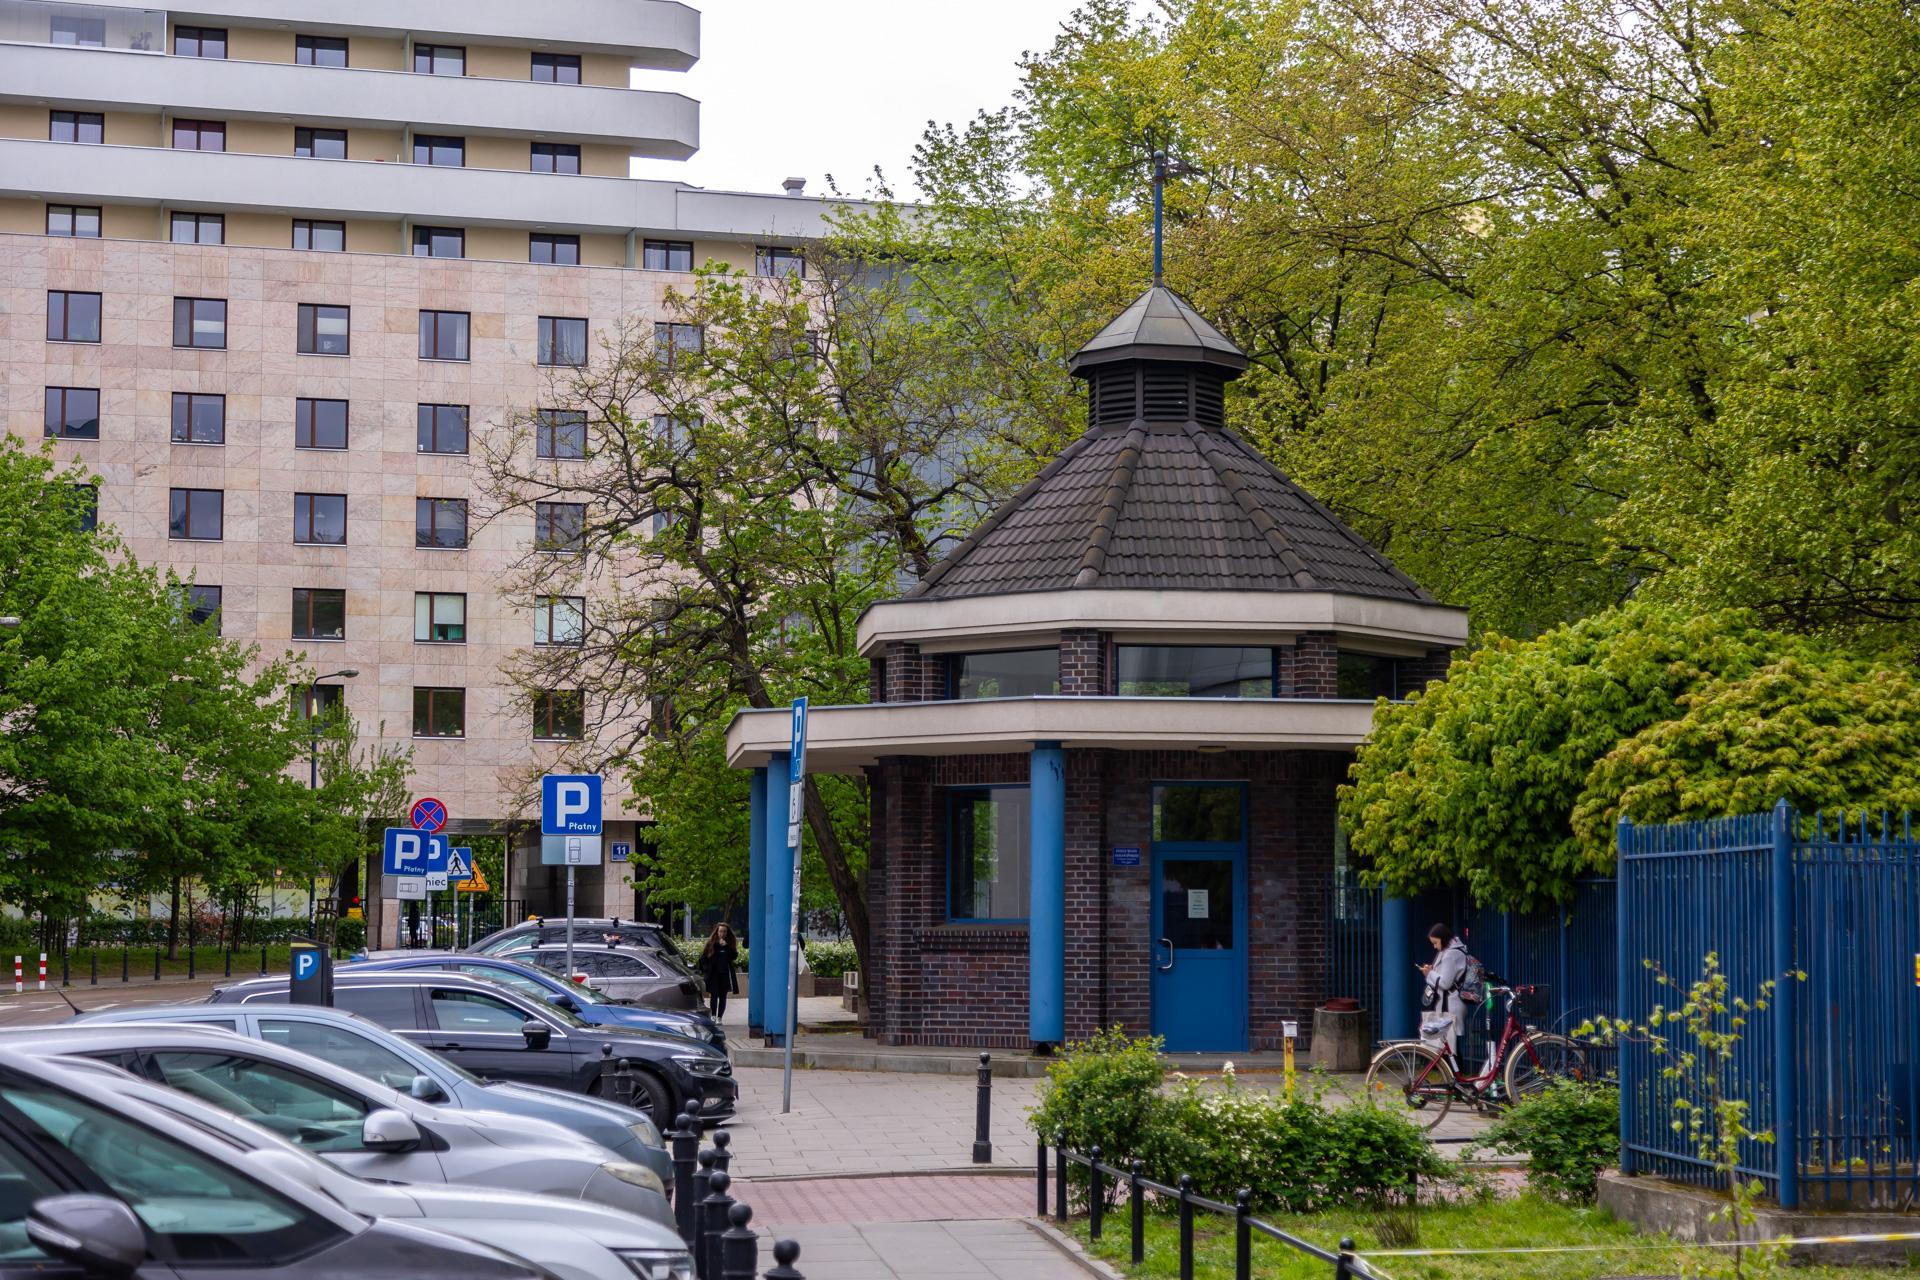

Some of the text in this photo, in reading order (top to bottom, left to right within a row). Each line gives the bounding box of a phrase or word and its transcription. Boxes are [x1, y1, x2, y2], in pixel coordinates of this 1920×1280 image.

[794, 706, 802, 757] P
[557, 782, 589, 827] P
[569, 822, 597, 832] Płatny
[394, 834, 420, 869] P
[616, 846, 627, 855] 11
[300, 954, 312, 975] P
